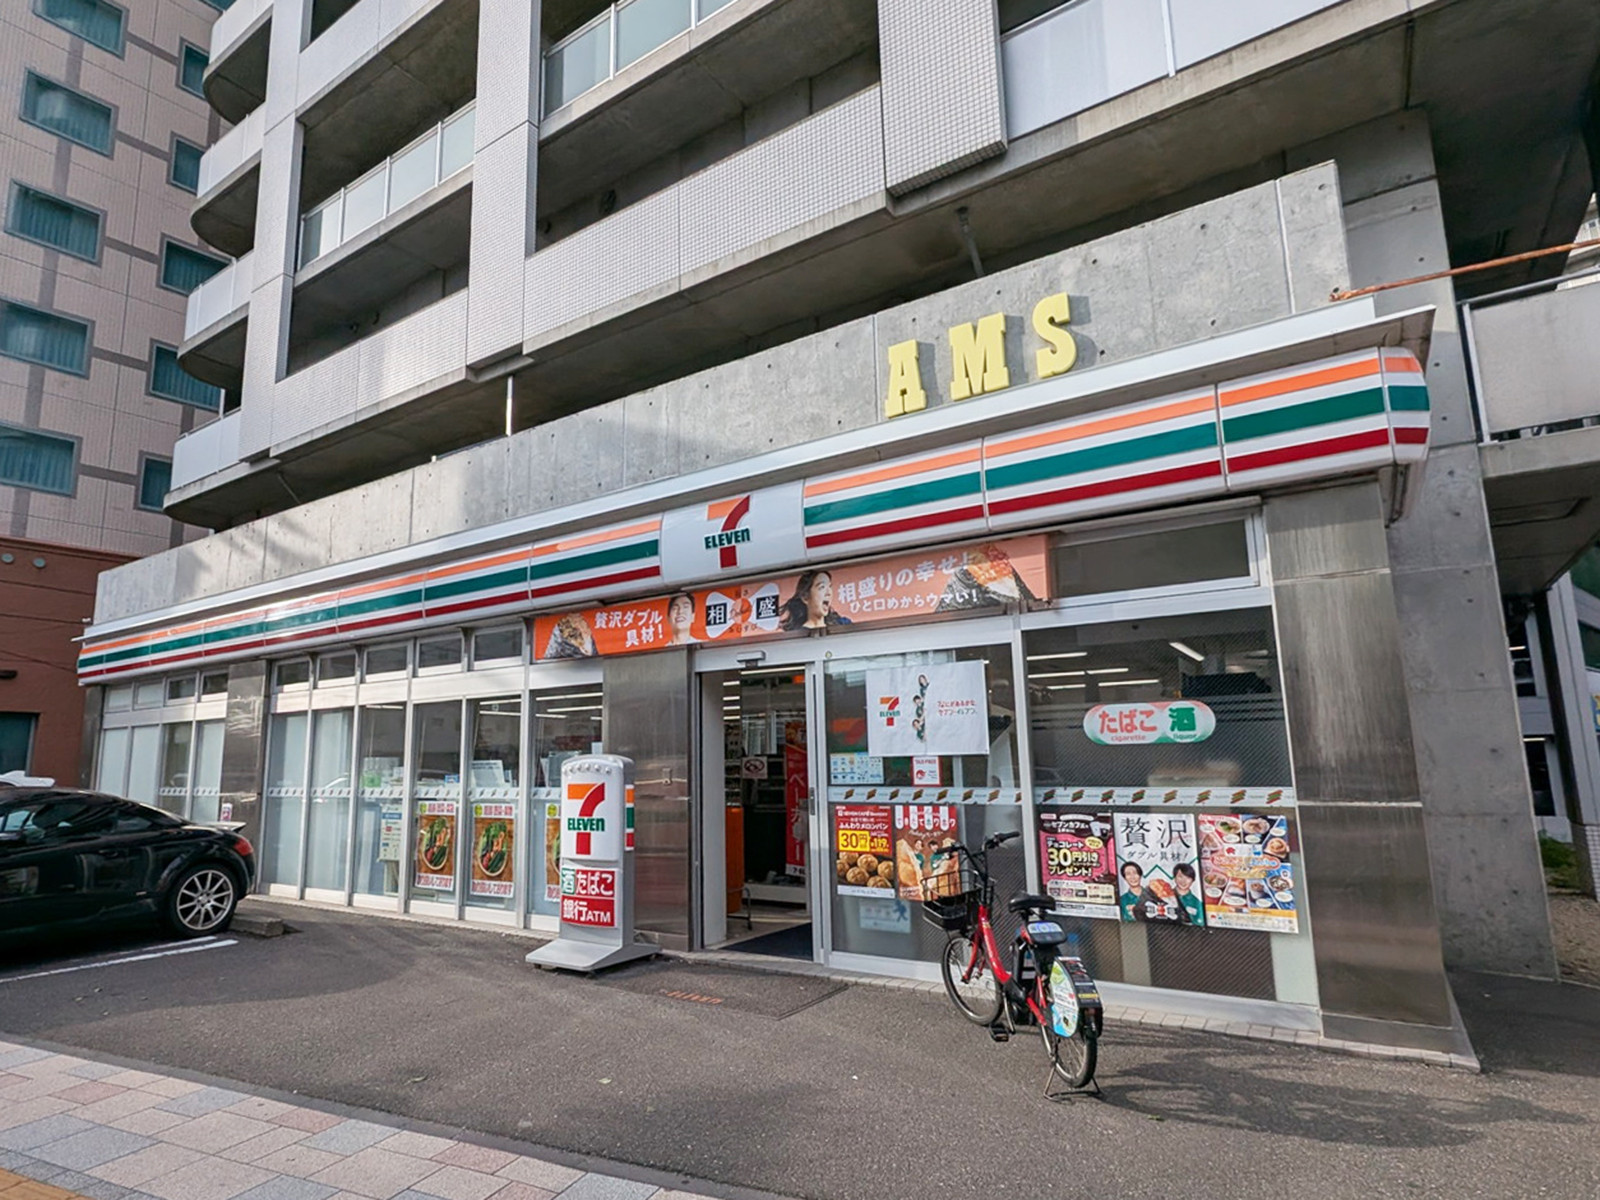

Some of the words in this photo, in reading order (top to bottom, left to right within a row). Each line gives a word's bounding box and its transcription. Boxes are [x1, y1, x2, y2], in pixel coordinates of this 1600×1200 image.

[885, 292, 1077, 418] AMS
[707, 495, 750, 568] 7
[594, 609, 663, 630] 贅沢ダブル
[625, 624, 664, 648] 具材！
[1099, 708, 1158, 734] たばこ
[1169, 707, 1197, 732] 酒
[567, 782, 605, 855] 7
[1046, 840, 1085, 849] チョコレート
[1120, 817, 1191, 849] 贅沢
[1048, 848, 1099, 867] 30円引き
[561, 869, 575, 894] 酒
[576, 871, 614, 895] たばこ
